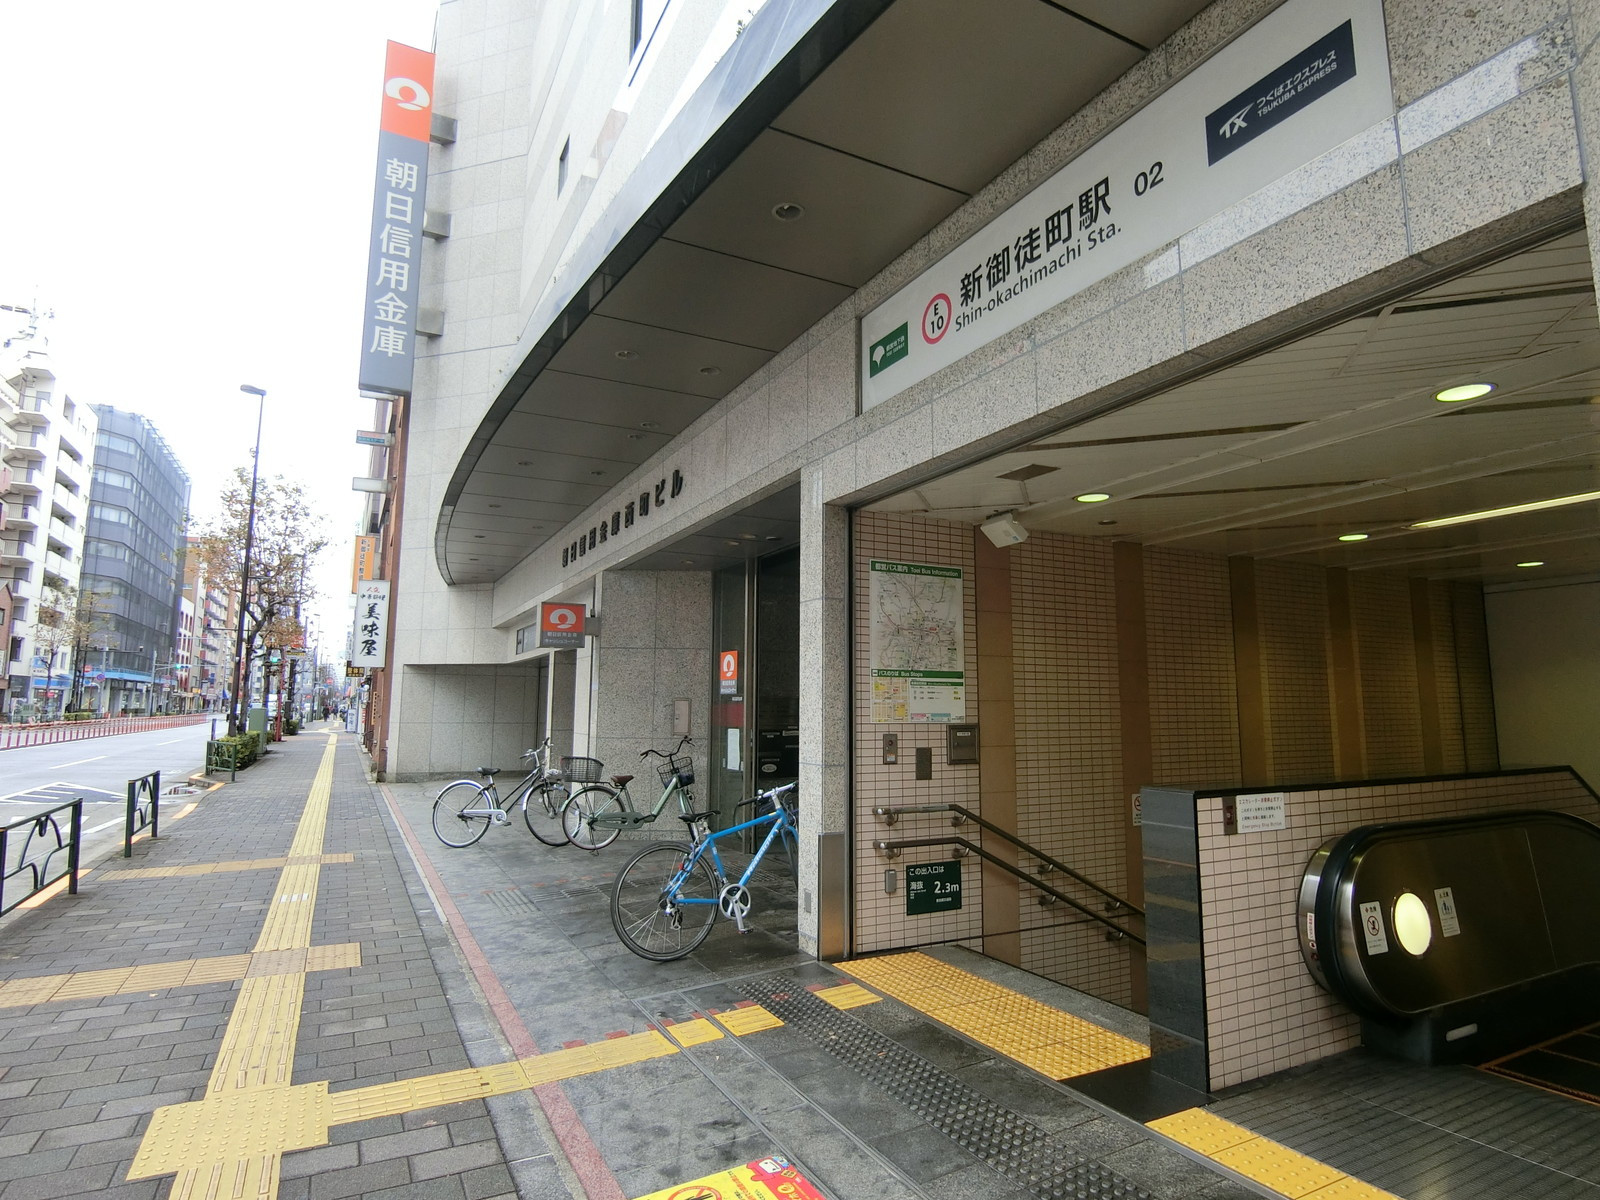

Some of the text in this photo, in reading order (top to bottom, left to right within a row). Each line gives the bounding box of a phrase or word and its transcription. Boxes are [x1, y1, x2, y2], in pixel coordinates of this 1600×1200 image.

[1257, 50, 1337, 108] つくばエクスプレス
[1257, 62, 1338, 117] TSUKUBA EXPRESS
[1219, 103, 1254, 138] TX
[1133, 161, 1165, 197] 02
[370, 157, 419, 359] 朝日信用金庫
[959, 176, 1112, 307] 新御徒町駅
[955, 227, 1122, 333] Shin-okachimachi Sta.
[929, 315, 944, 336] 10
[933, 303, 940, 316] E
[360, 602, 381, 657] 美味屋
[909, 866, 945, 876] この出入口は
[934, 880, 960, 894] 2.3m
